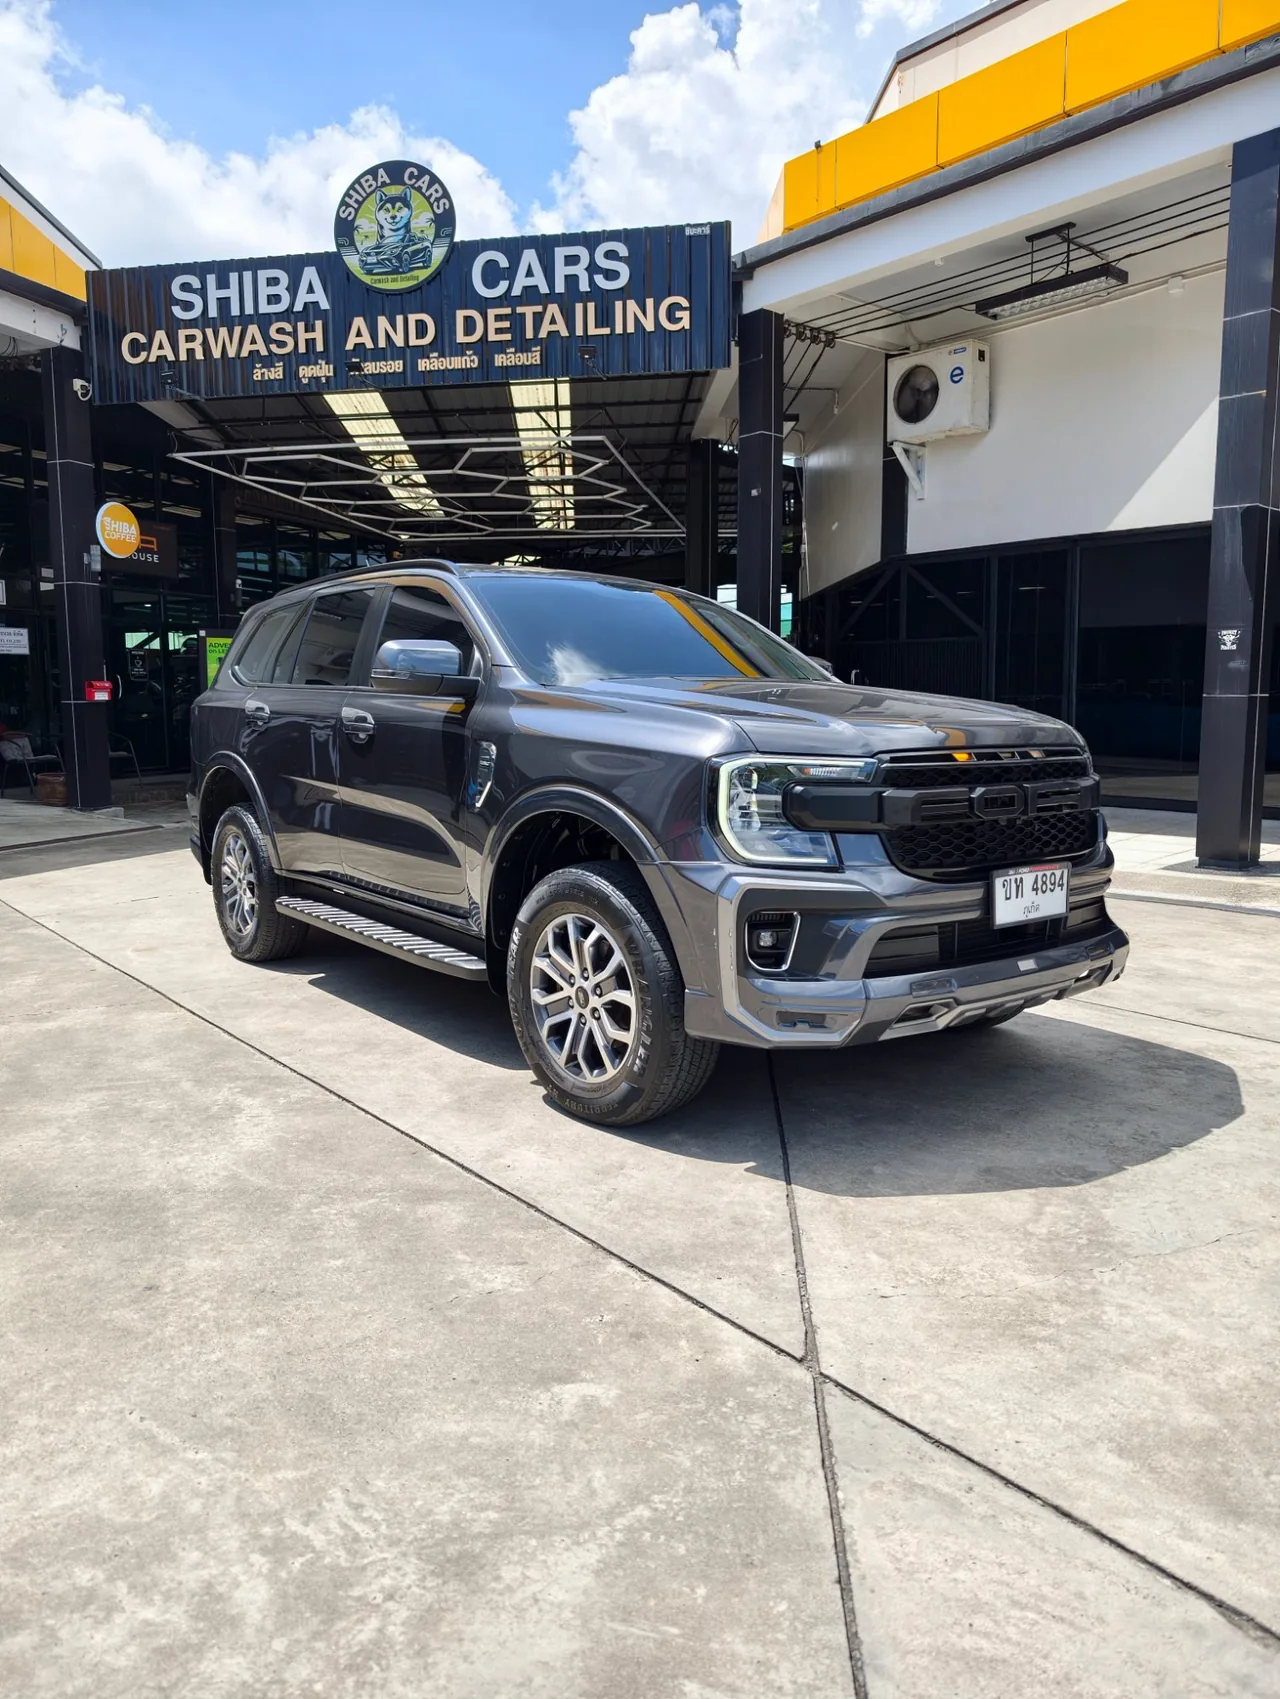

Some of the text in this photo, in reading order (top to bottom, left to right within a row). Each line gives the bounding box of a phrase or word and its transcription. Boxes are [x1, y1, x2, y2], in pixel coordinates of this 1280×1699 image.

[338, 167, 450, 221] SHIBA CARS
[170, 241, 630, 320] SHIBA CARS
[121, 295, 690, 365] CARWASH AND DETAILING
[252, 361, 284, 381] ล้างสี
[298, 359, 334, 384] ดูดฝุ่น
[417, 350, 479, 372] เคลือบแก้ว
[494, 346, 541, 367] เคลือบสี
[101, 517, 136, 534] SHIBA
[104, 530, 136, 543] COFFEE
[129, 551, 159, 563] OUSE
[1002, 870, 1065, 901] ขท 4894
